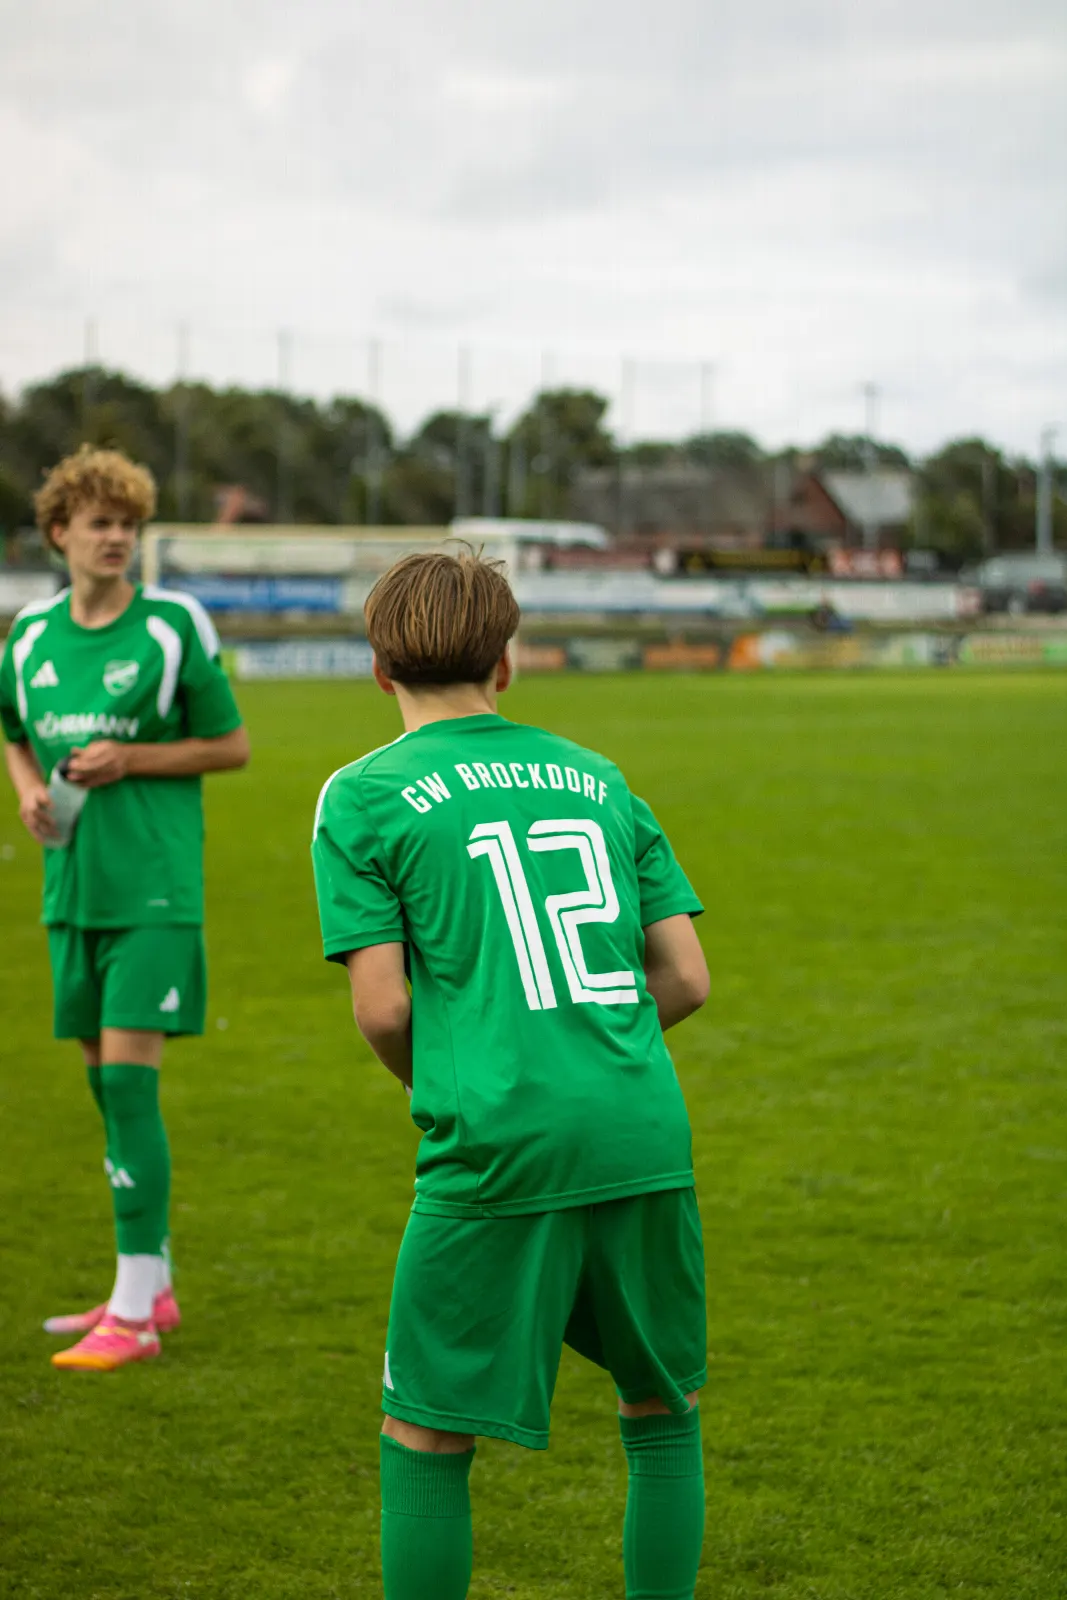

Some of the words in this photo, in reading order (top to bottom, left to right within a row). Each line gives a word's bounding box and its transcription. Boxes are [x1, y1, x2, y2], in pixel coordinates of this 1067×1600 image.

[401, 772, 452, 814] GW
[455, 762, 609, 805] BROCKDORF
[466, 818, 640, 1011] 12
